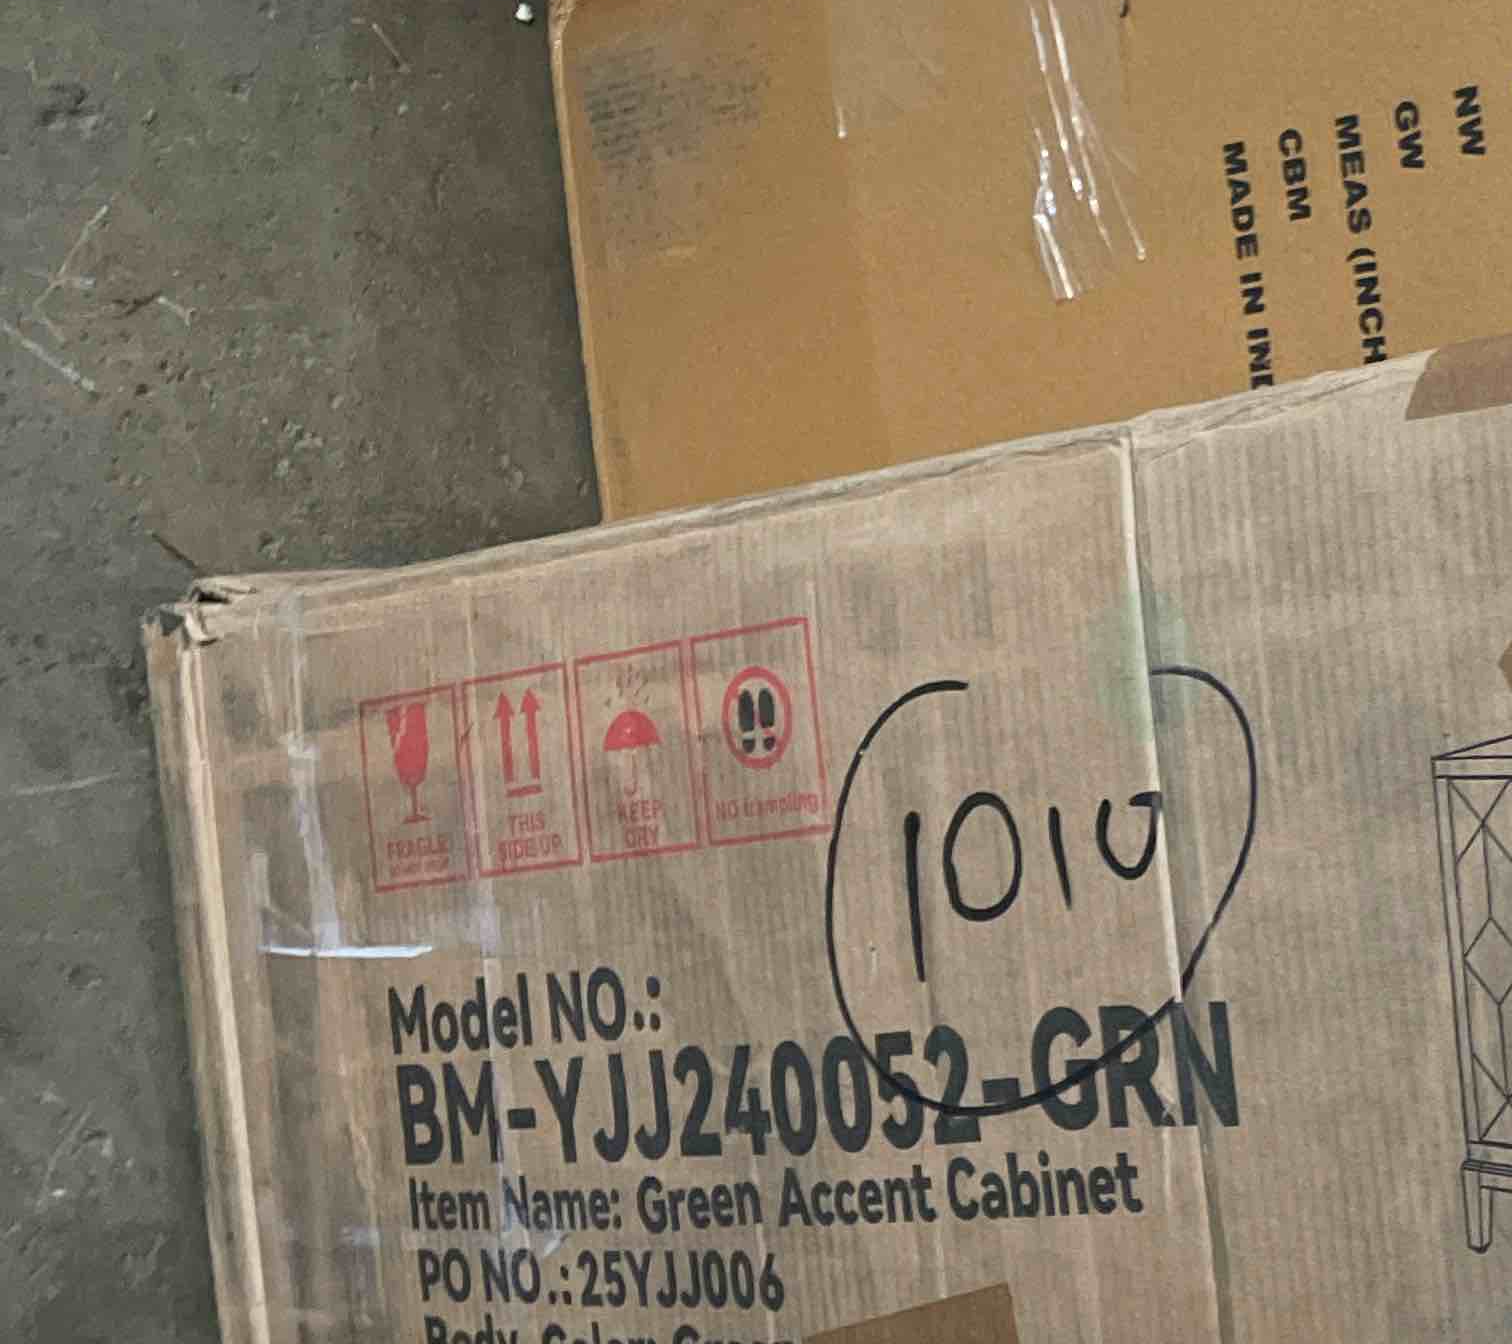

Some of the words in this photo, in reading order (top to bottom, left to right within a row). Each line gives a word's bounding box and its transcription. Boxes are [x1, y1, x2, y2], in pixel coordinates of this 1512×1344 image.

[1394, 101, 1425, 168] GW
[1453, 85, 1486, 155] NW
[1222, 141, 1259, 260] MADE
[1279, 128, 1312, 222] CBM
[1335, 114, 1372, 234] MEAS
[1240, 272, 1265, 315] IN
[1346, 247, 1387, 365] (INCH
[510, 812, 545, 835] THIS
[616, 800, 664, 824] KEEP
[624, 825, 658, 848] DRY
[715, 799, 737, 820] NO
[388, 972, 533, 1054] Model
[547, 966, 661, 1042] NO.:
[396, 1001, 1240, 1165] BM-YJJ240052-GRN
[408, 1176, 490, 1232] Item
[503, 1175, 623, 1232] Name:
[637, 1176, 762, 1234] Green
[779, 1163, 938, 1226] Accent
[947, 1150, 1145, 1220] Cabinet
[417, 1248, 471, 1303] PO
